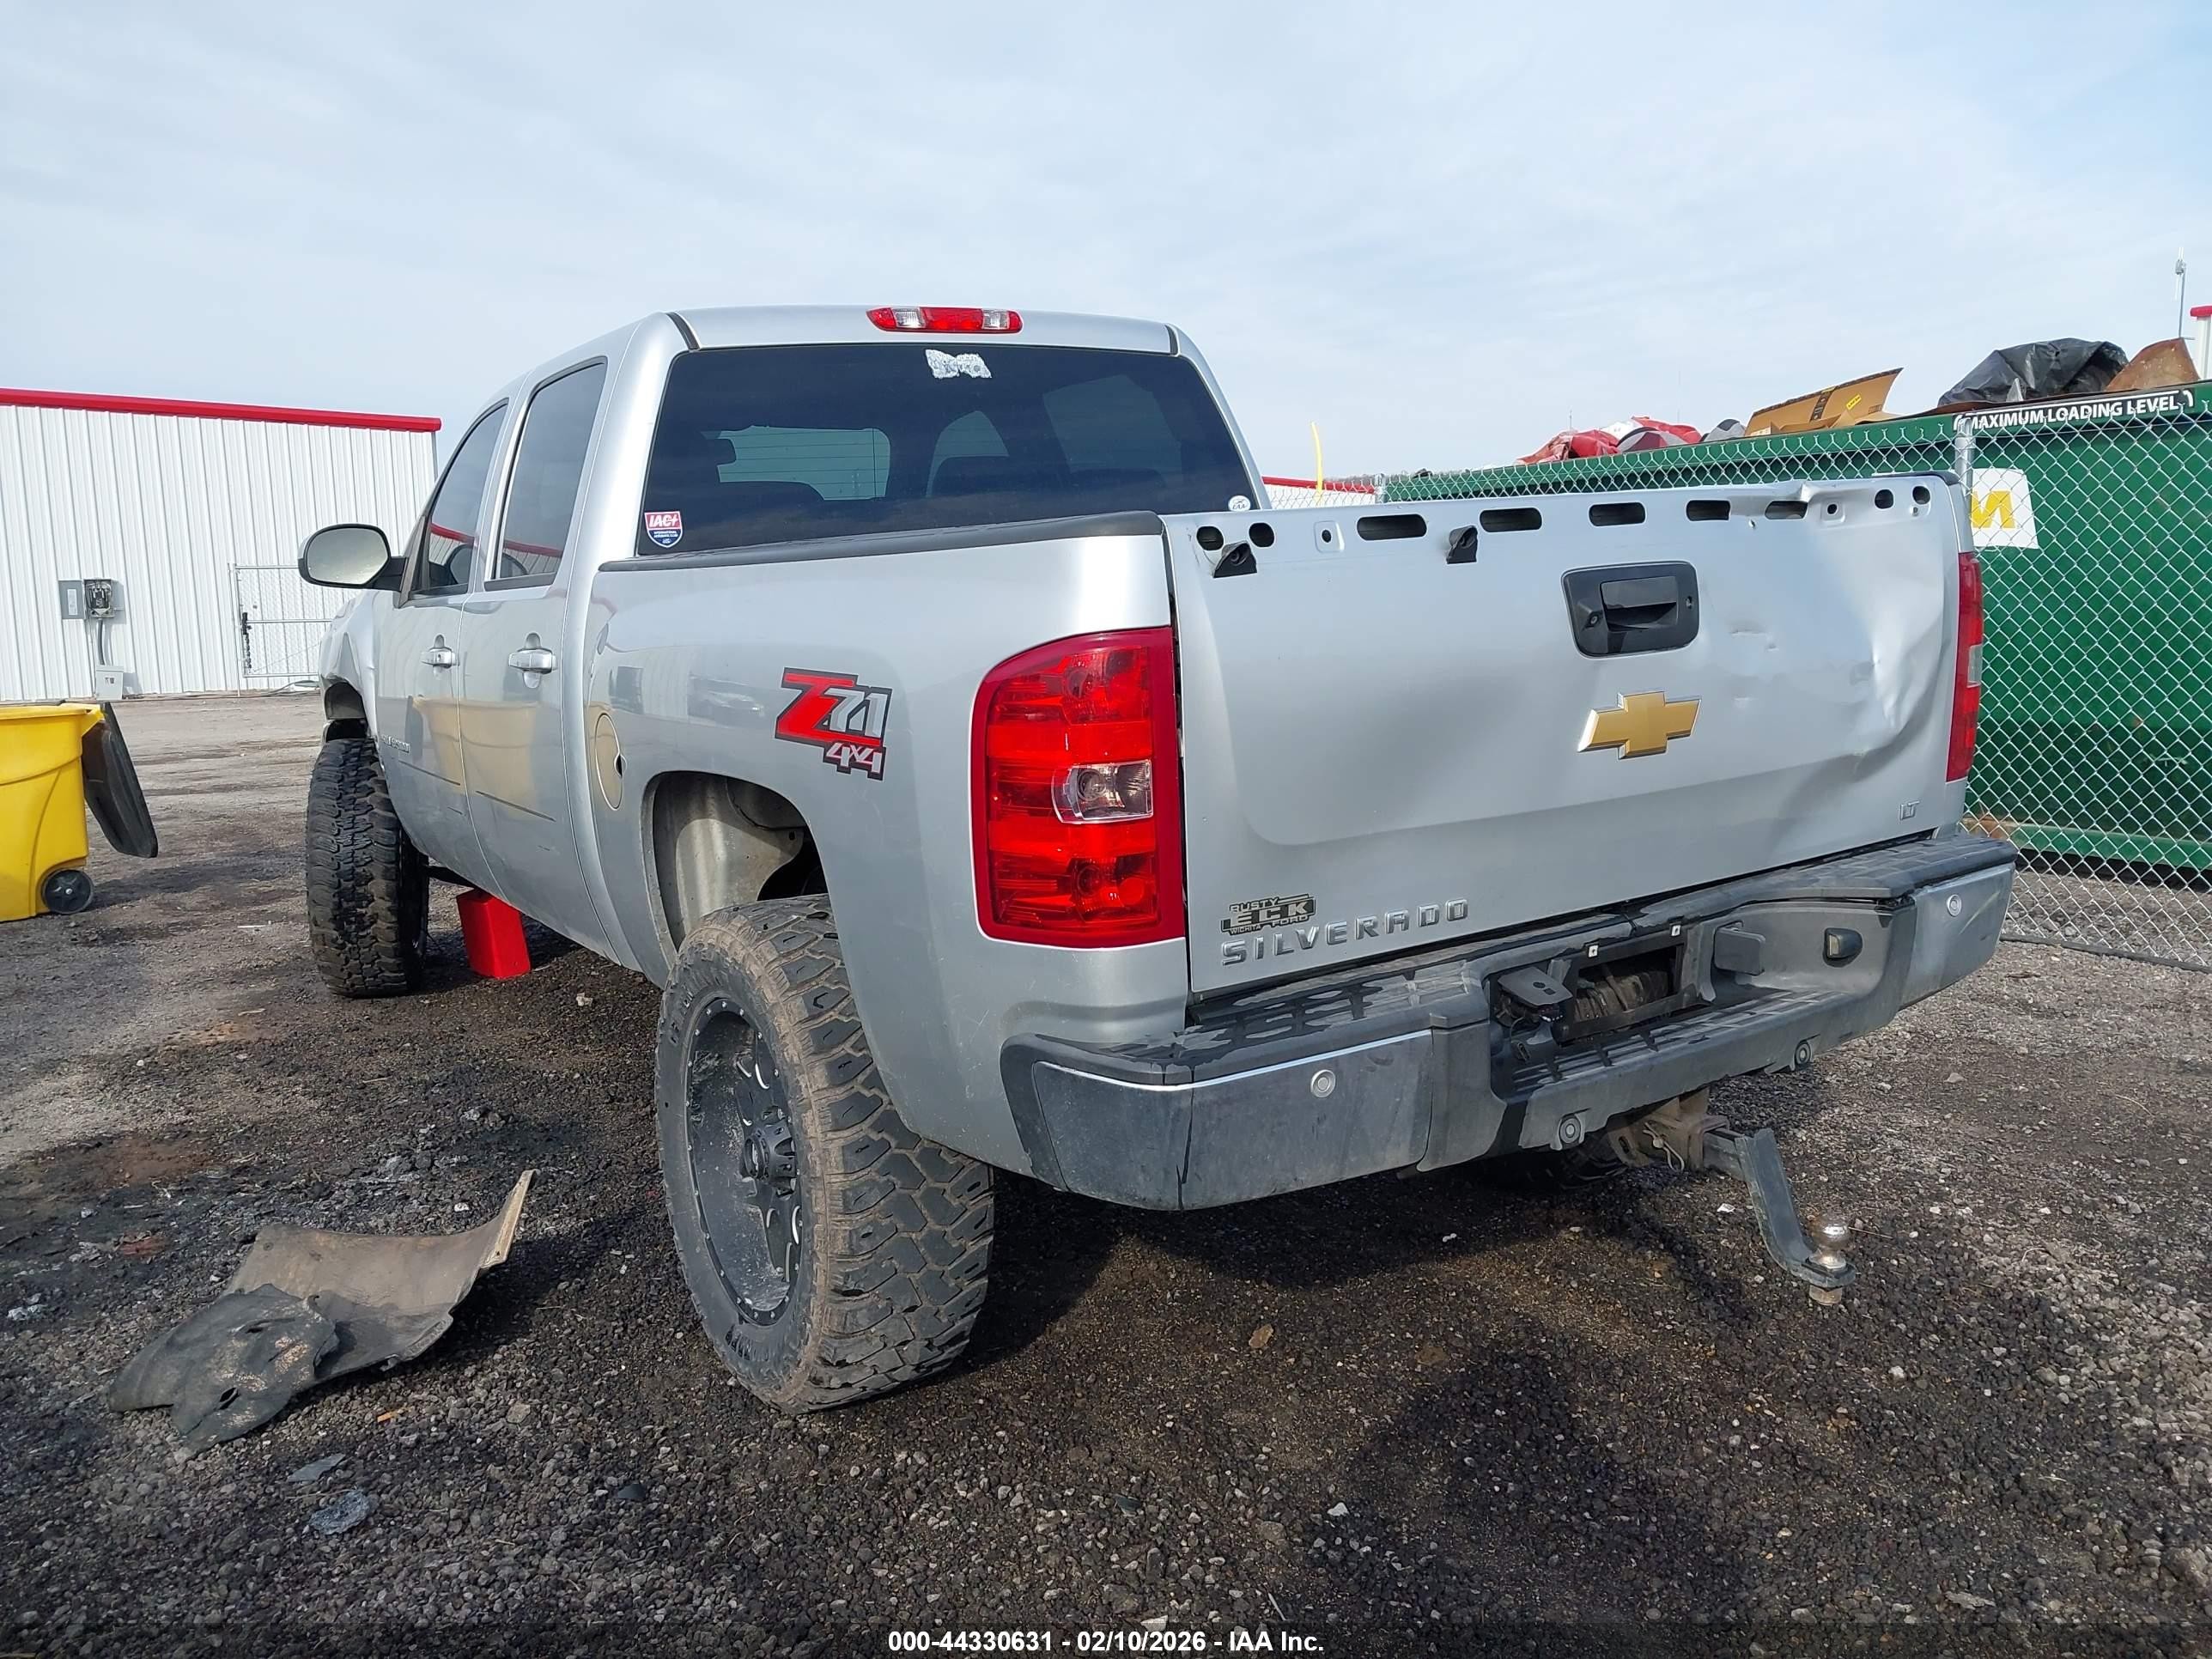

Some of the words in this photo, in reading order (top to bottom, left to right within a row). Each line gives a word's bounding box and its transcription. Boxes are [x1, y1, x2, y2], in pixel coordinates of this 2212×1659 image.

[2047, 402, 2123, 423] LOADING
[2127, 395, 2179, 416] LEVEL
[775, 666, 892, 747] Z71
[1899, 800, 1920, 821] LT
[1230, 897, 1279, 912] RUSTY
[1230, 902, 1308, 927] ECK
[1222, 898, 1468, 966] SILVERADO
[1272, 915, 1309, 927] FORD
